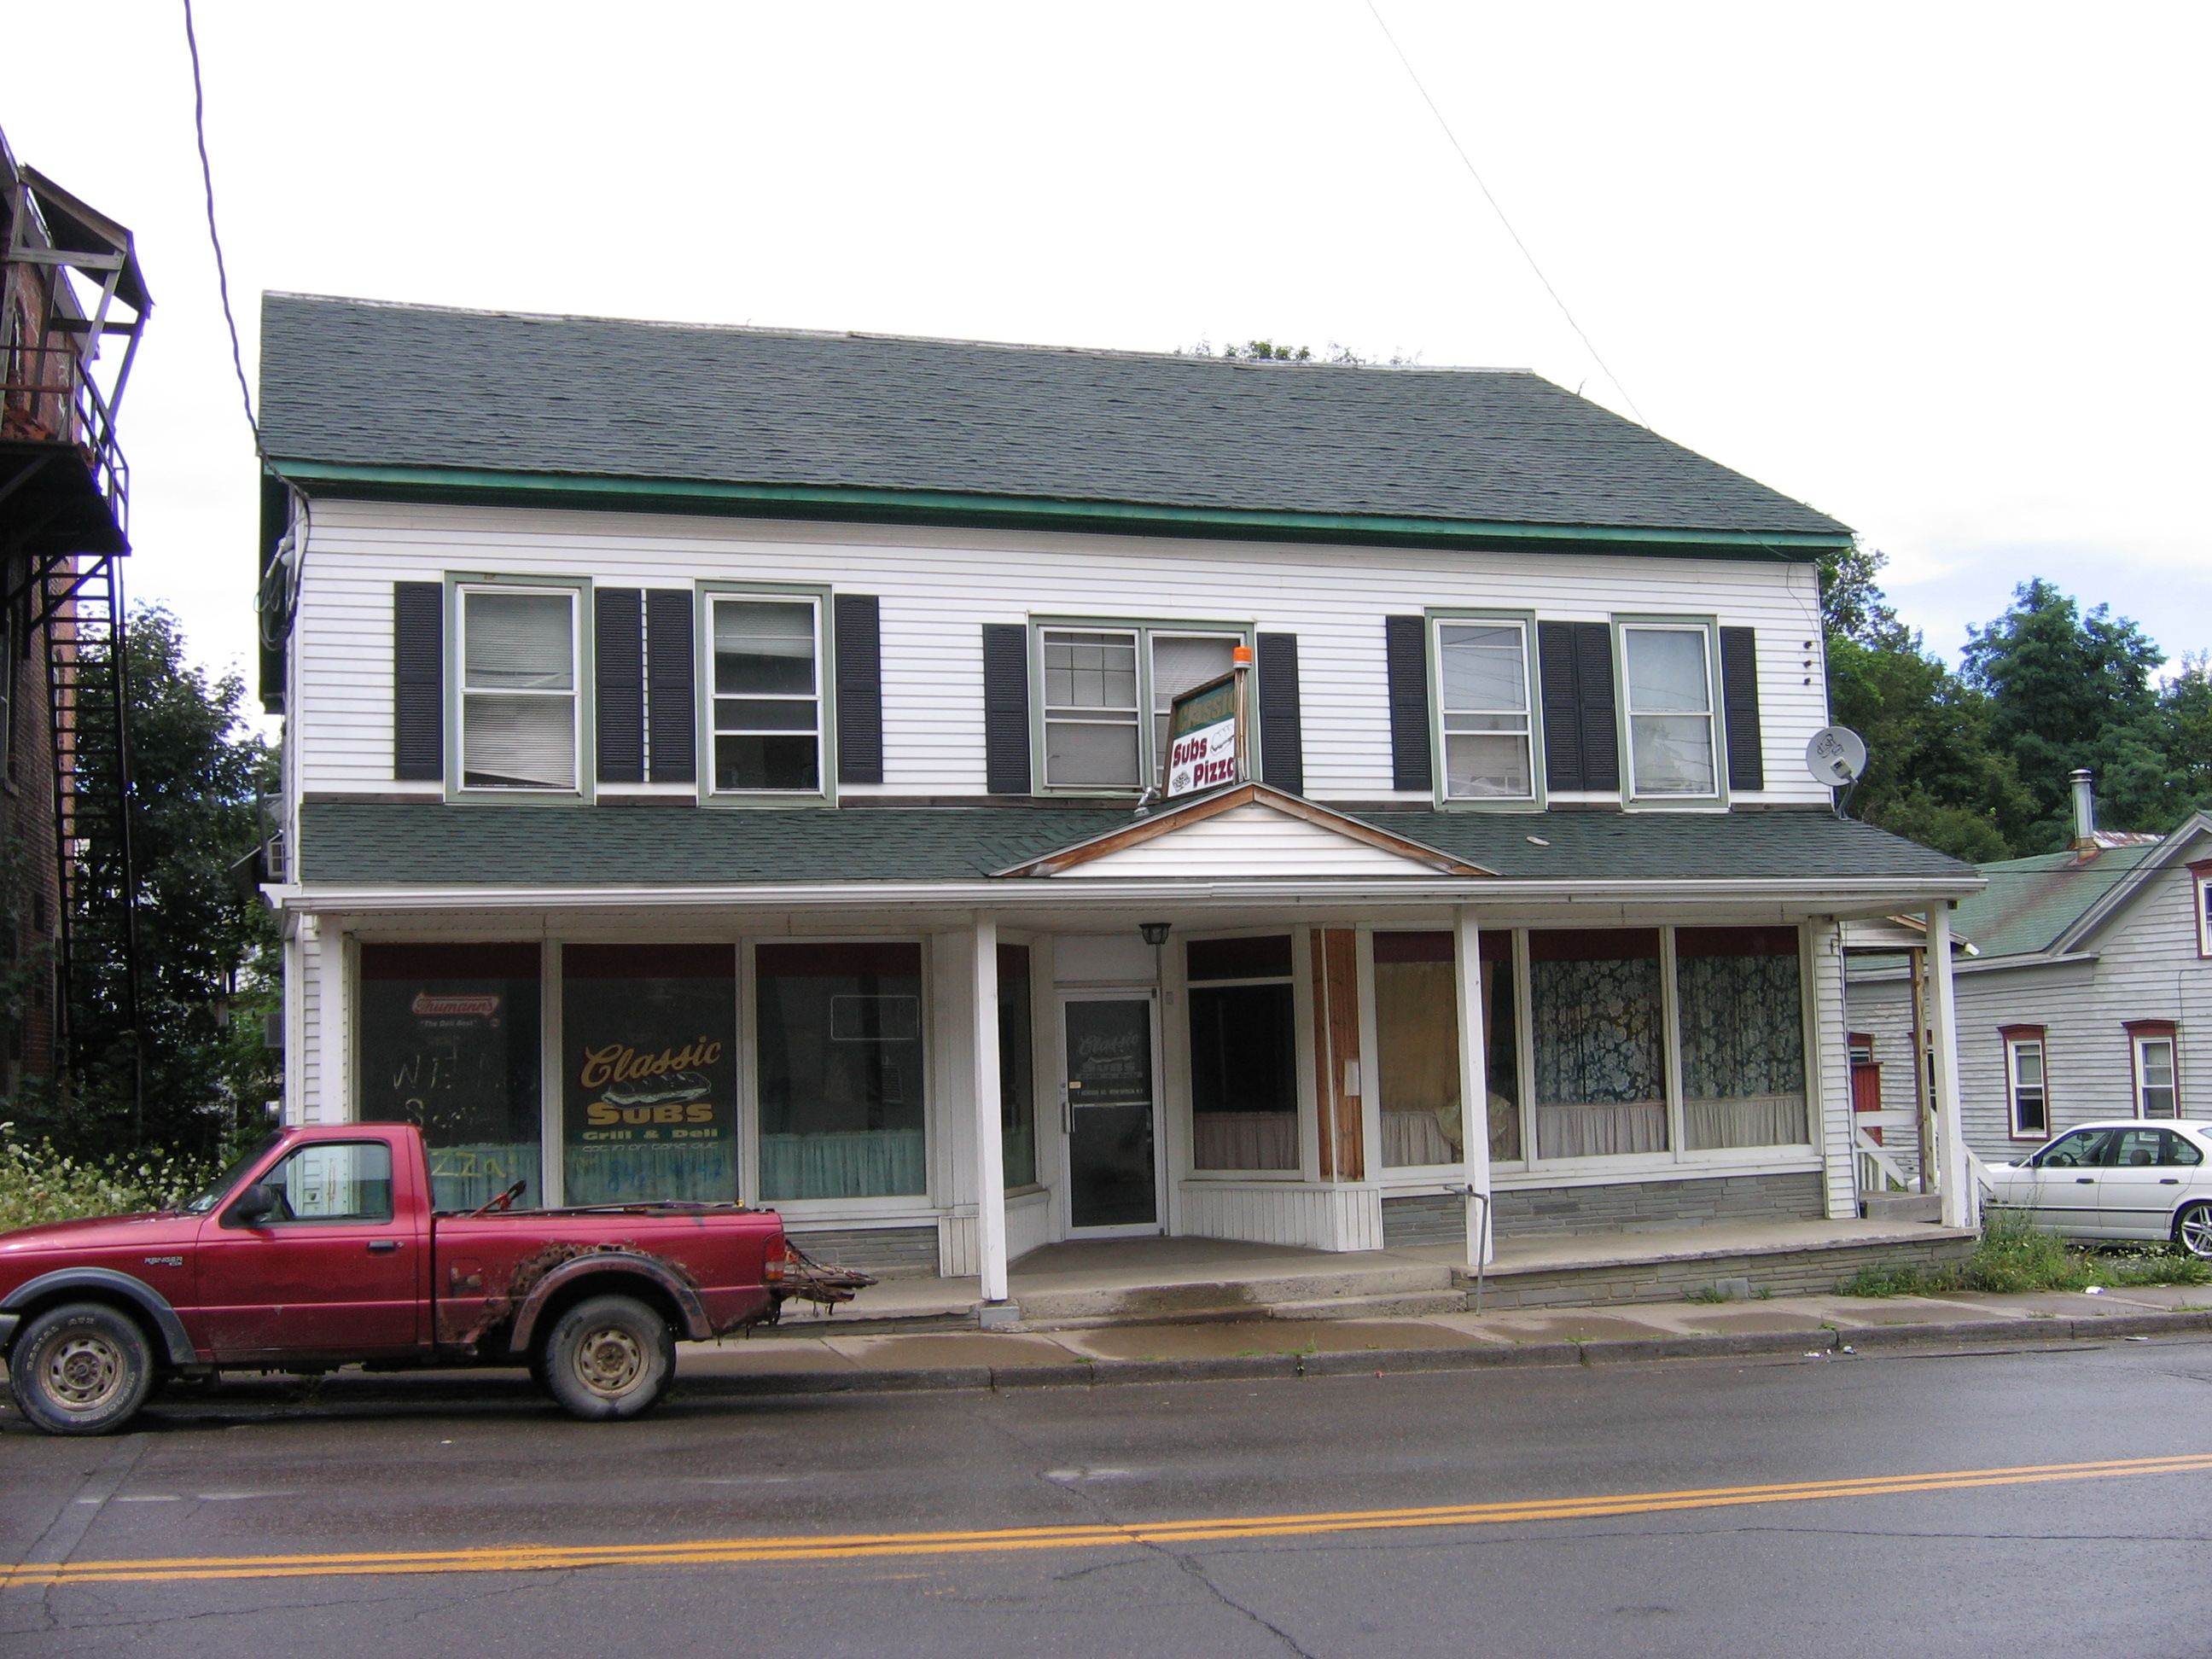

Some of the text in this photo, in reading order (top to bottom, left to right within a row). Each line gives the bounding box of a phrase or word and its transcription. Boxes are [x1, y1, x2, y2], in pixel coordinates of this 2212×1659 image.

[580, 1035, 722, 1089] Classic
[582, 1128, 719, 1140] Grill & Deli
